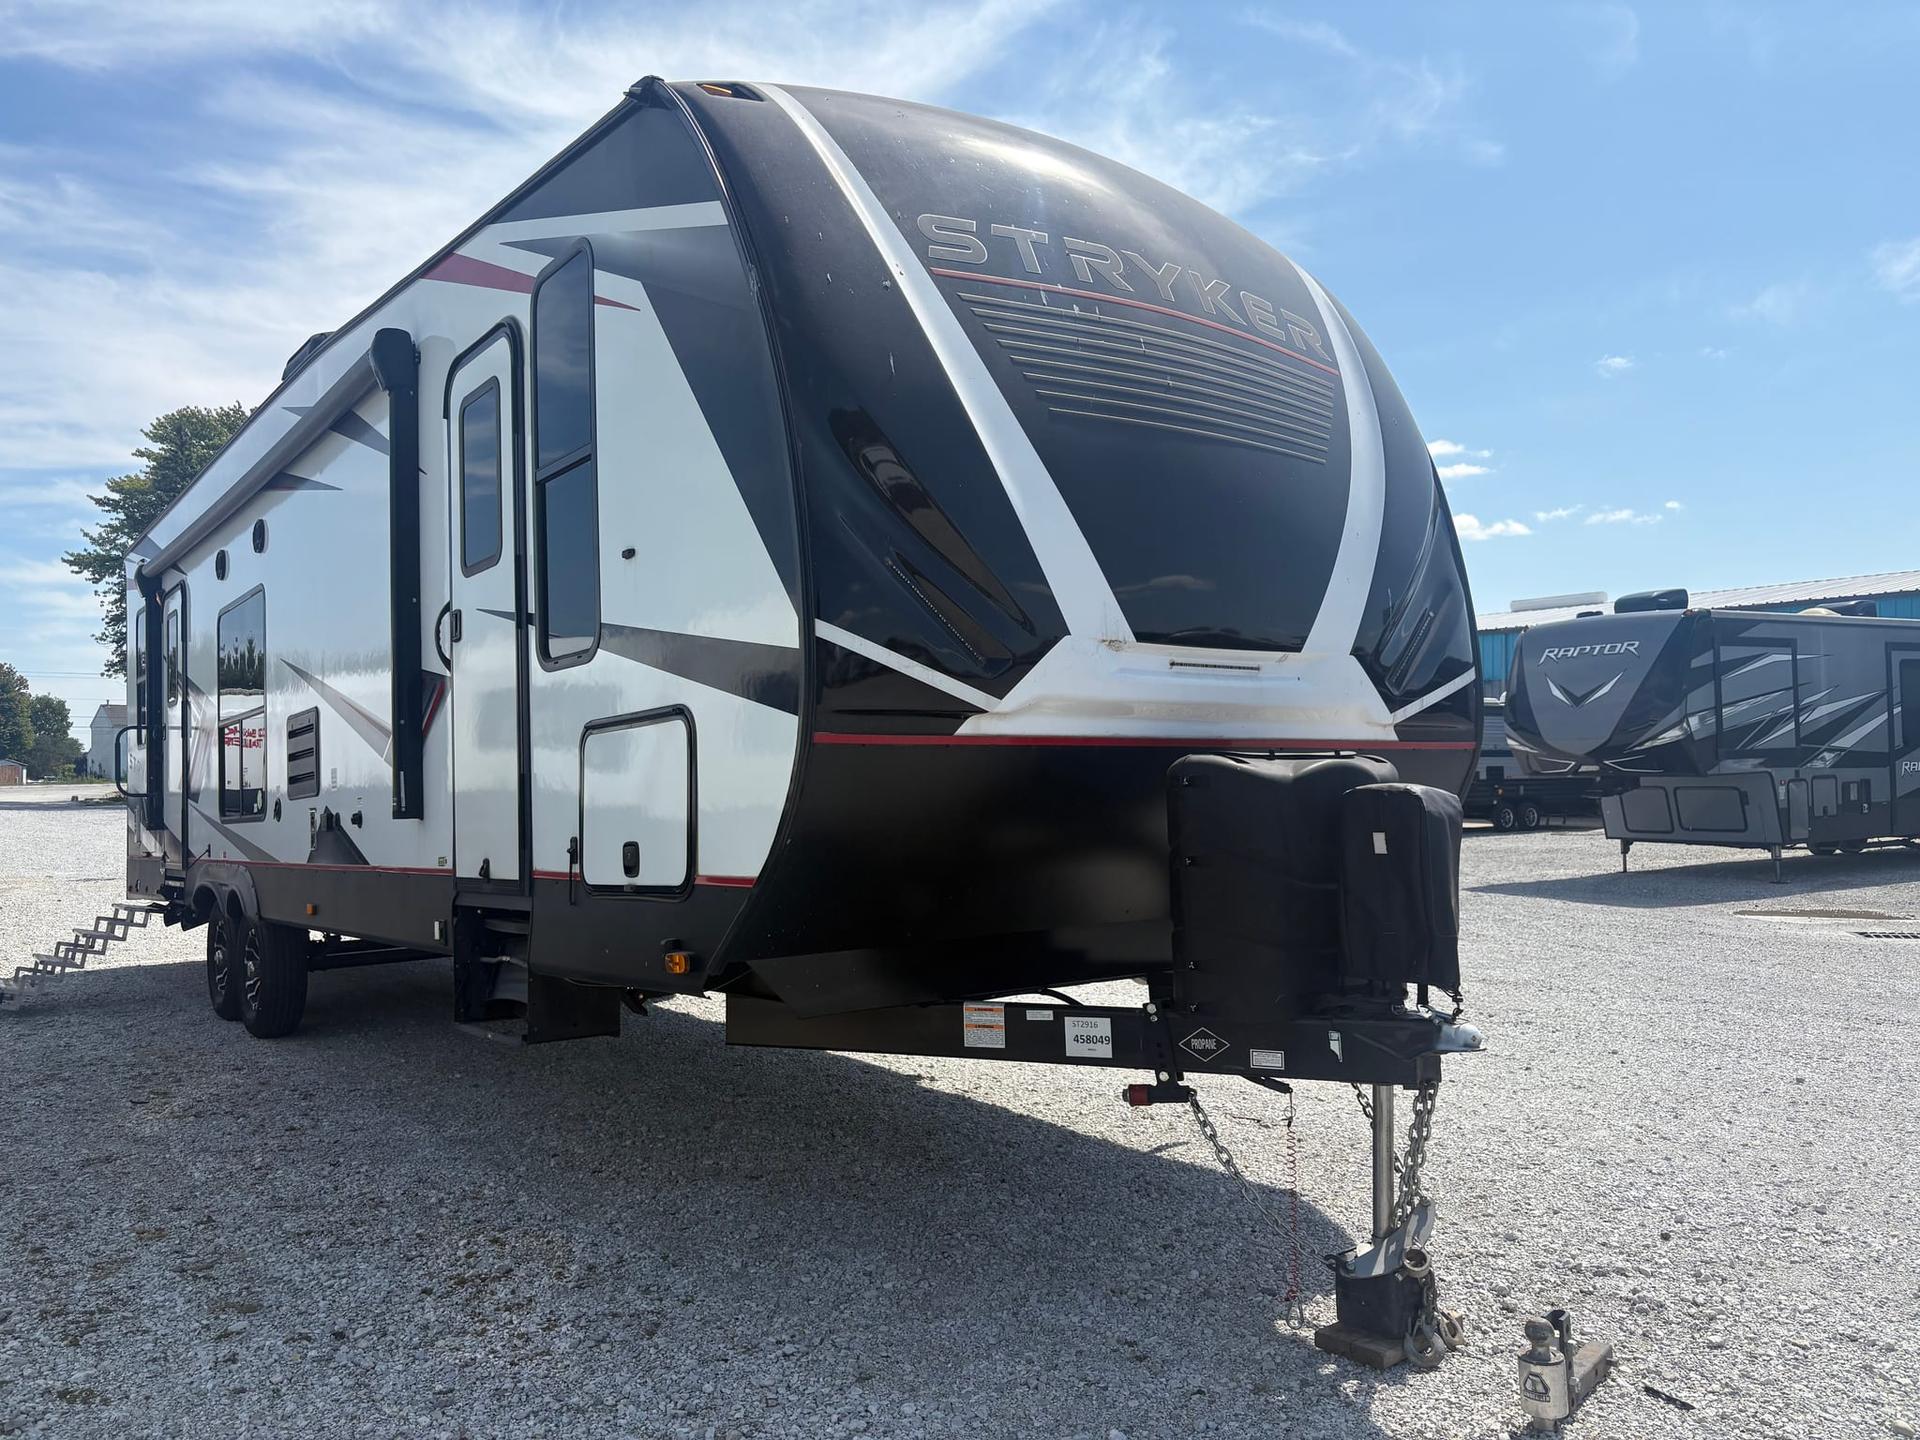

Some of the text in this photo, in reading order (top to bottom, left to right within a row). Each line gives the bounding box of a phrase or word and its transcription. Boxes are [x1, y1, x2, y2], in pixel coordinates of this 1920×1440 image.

[917, 213, 1332, 361] STRYKER
[1538, 641, 1640, 665] RAPTOR
[1901, 761, 1920, 777] RA
[1073, 1034, 1111, 1045] 458049
[1191, 1039, 1217, 1050] PROPANE
